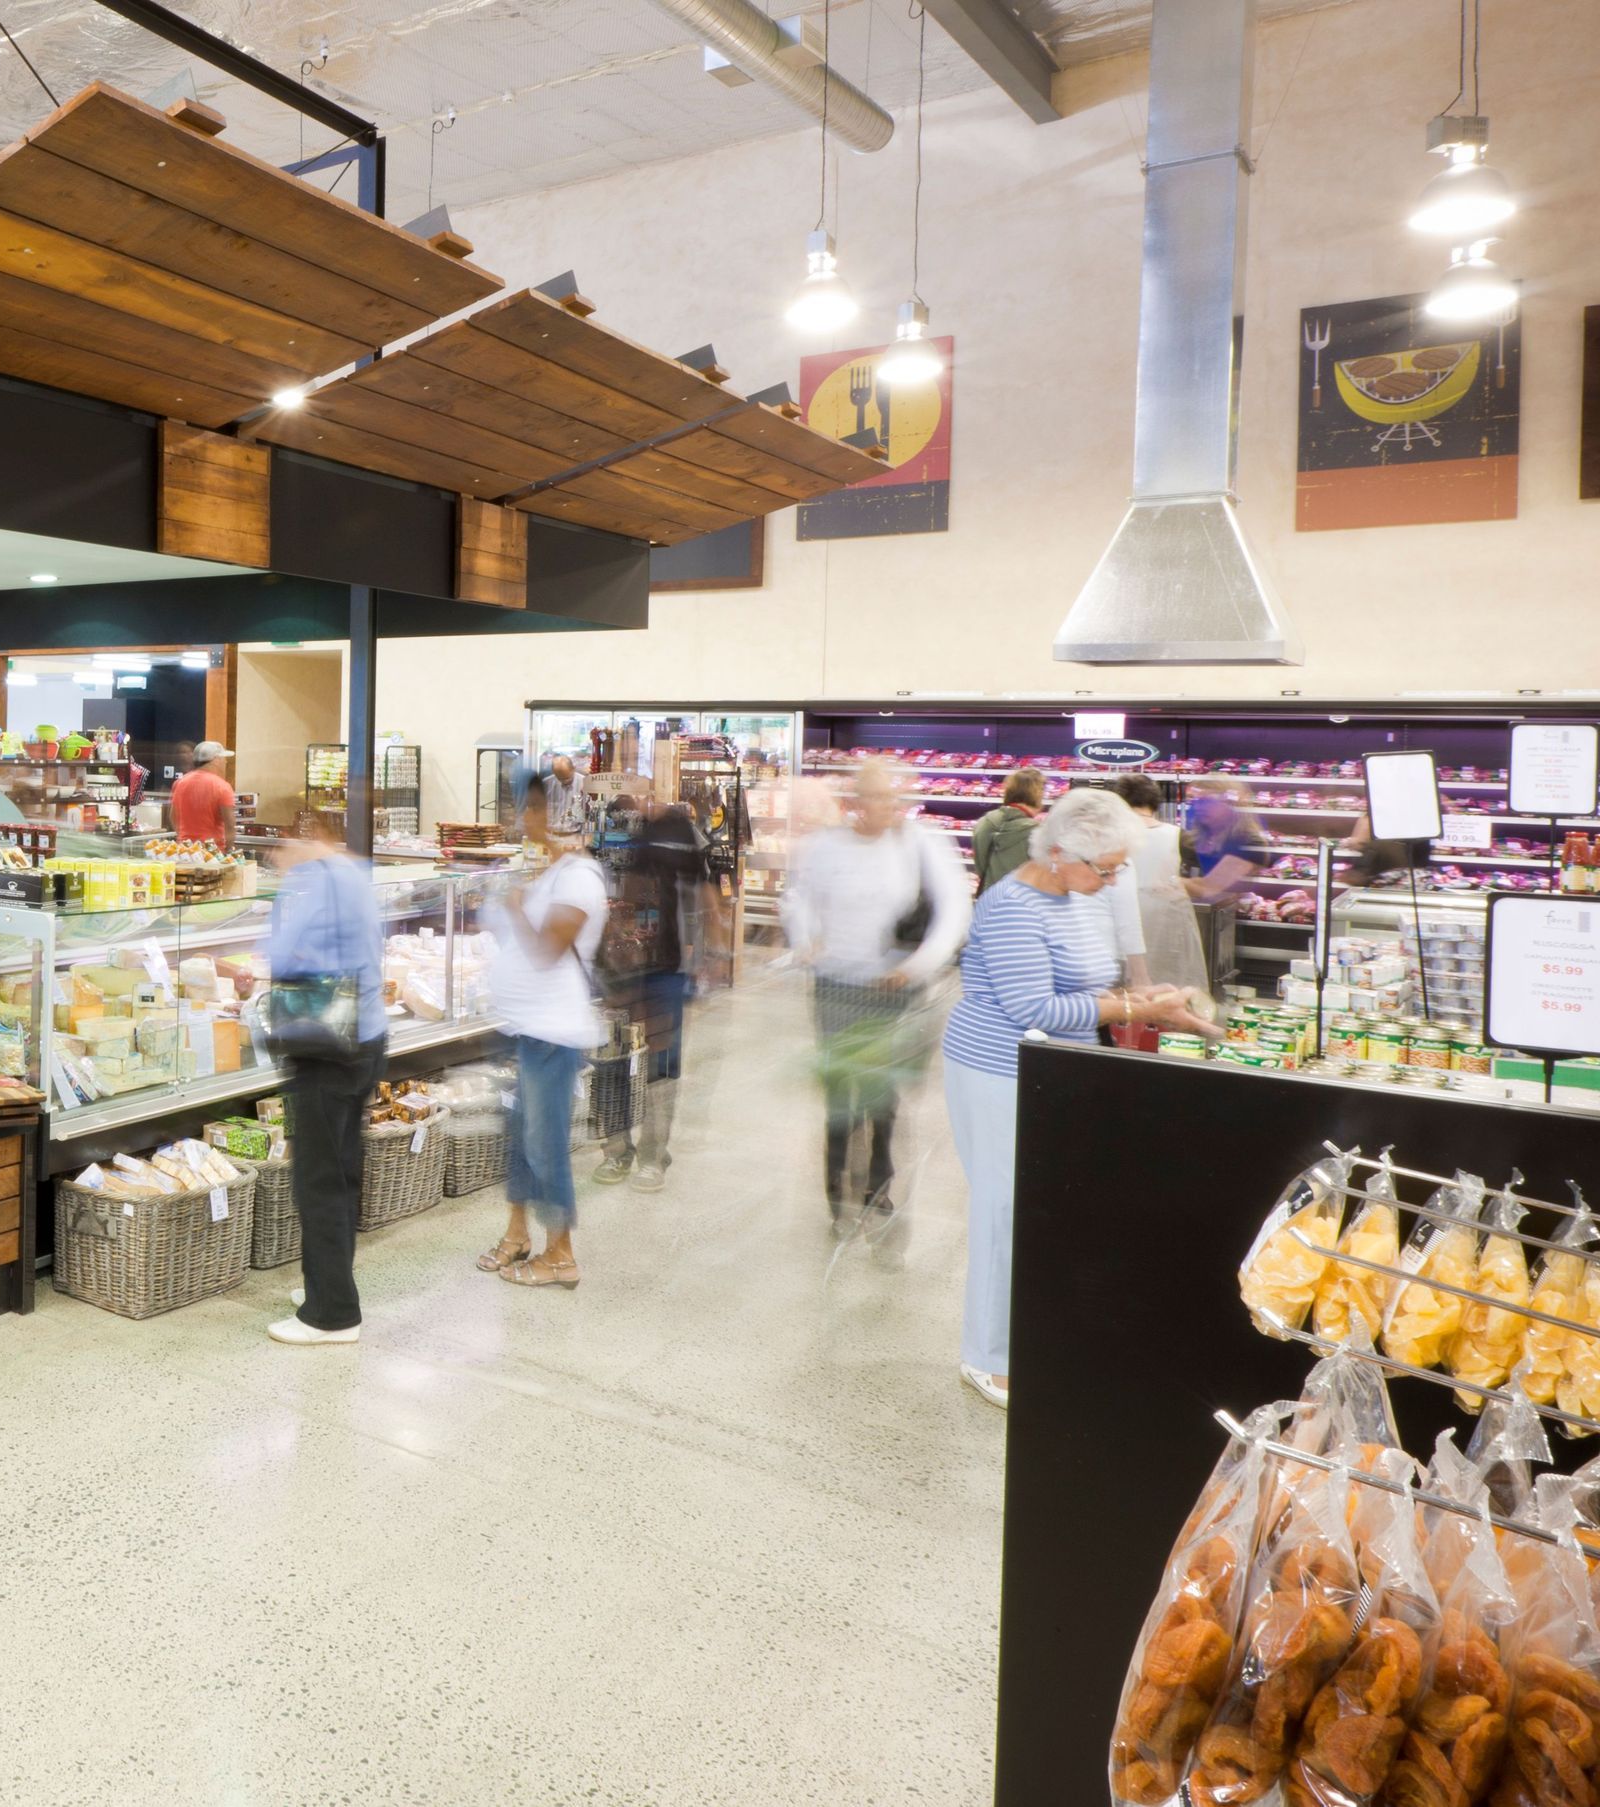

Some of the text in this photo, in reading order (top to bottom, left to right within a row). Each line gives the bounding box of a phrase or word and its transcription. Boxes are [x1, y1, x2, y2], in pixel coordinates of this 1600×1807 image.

[1087, 746, 1145, 759] Microplane
[1542, 963, 1584, 976] $5.99
[1541, 999, 1583, 1013] $5.99
